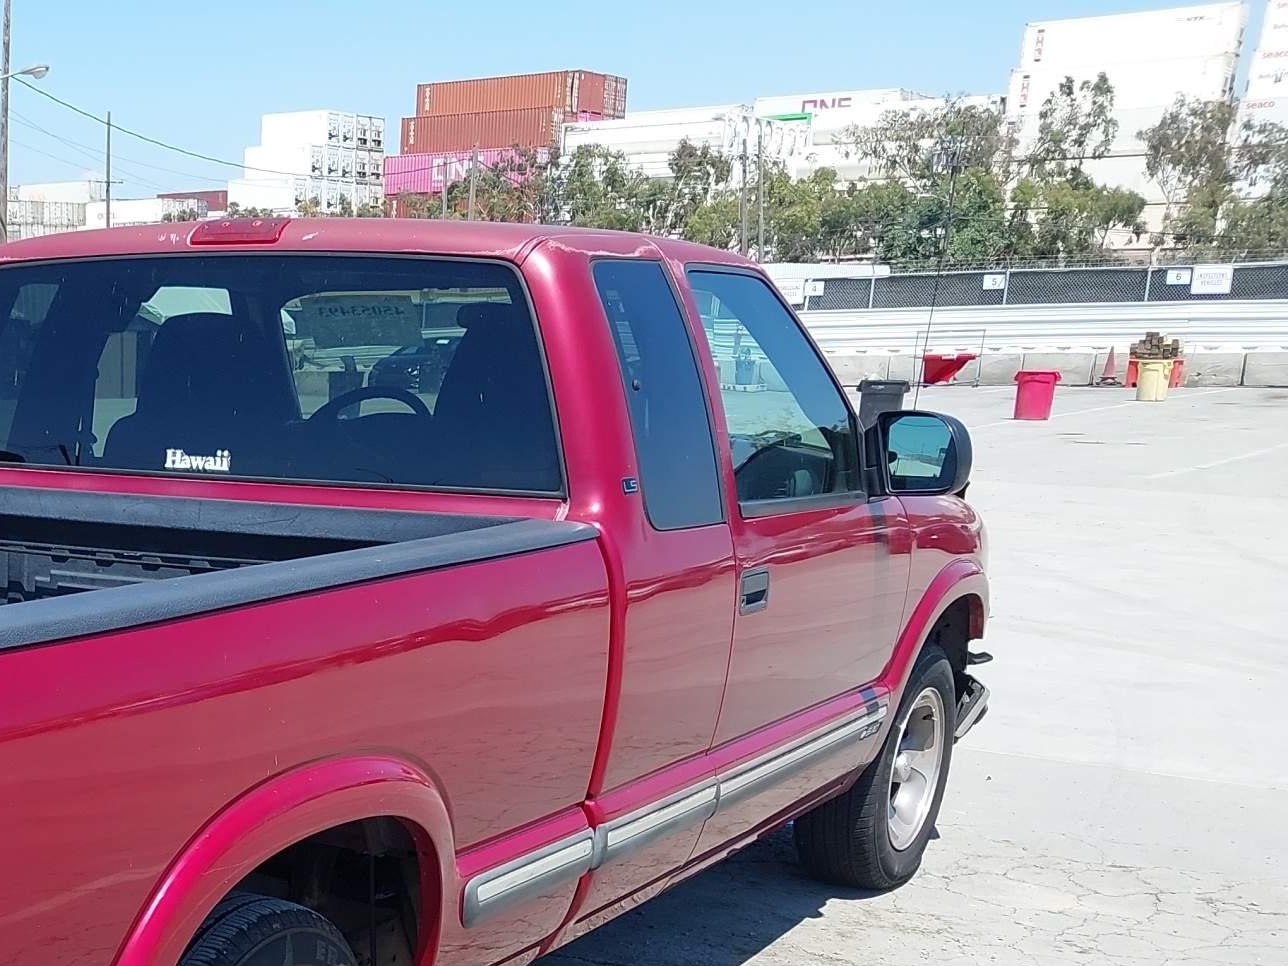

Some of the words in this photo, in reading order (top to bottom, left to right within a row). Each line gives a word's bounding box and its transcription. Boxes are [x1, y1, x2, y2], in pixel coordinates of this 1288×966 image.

[1245, 100, 1275, 110] seaco
[164, 448, 231, 472] Hawaii
[622, 478, 639, 494] LS
